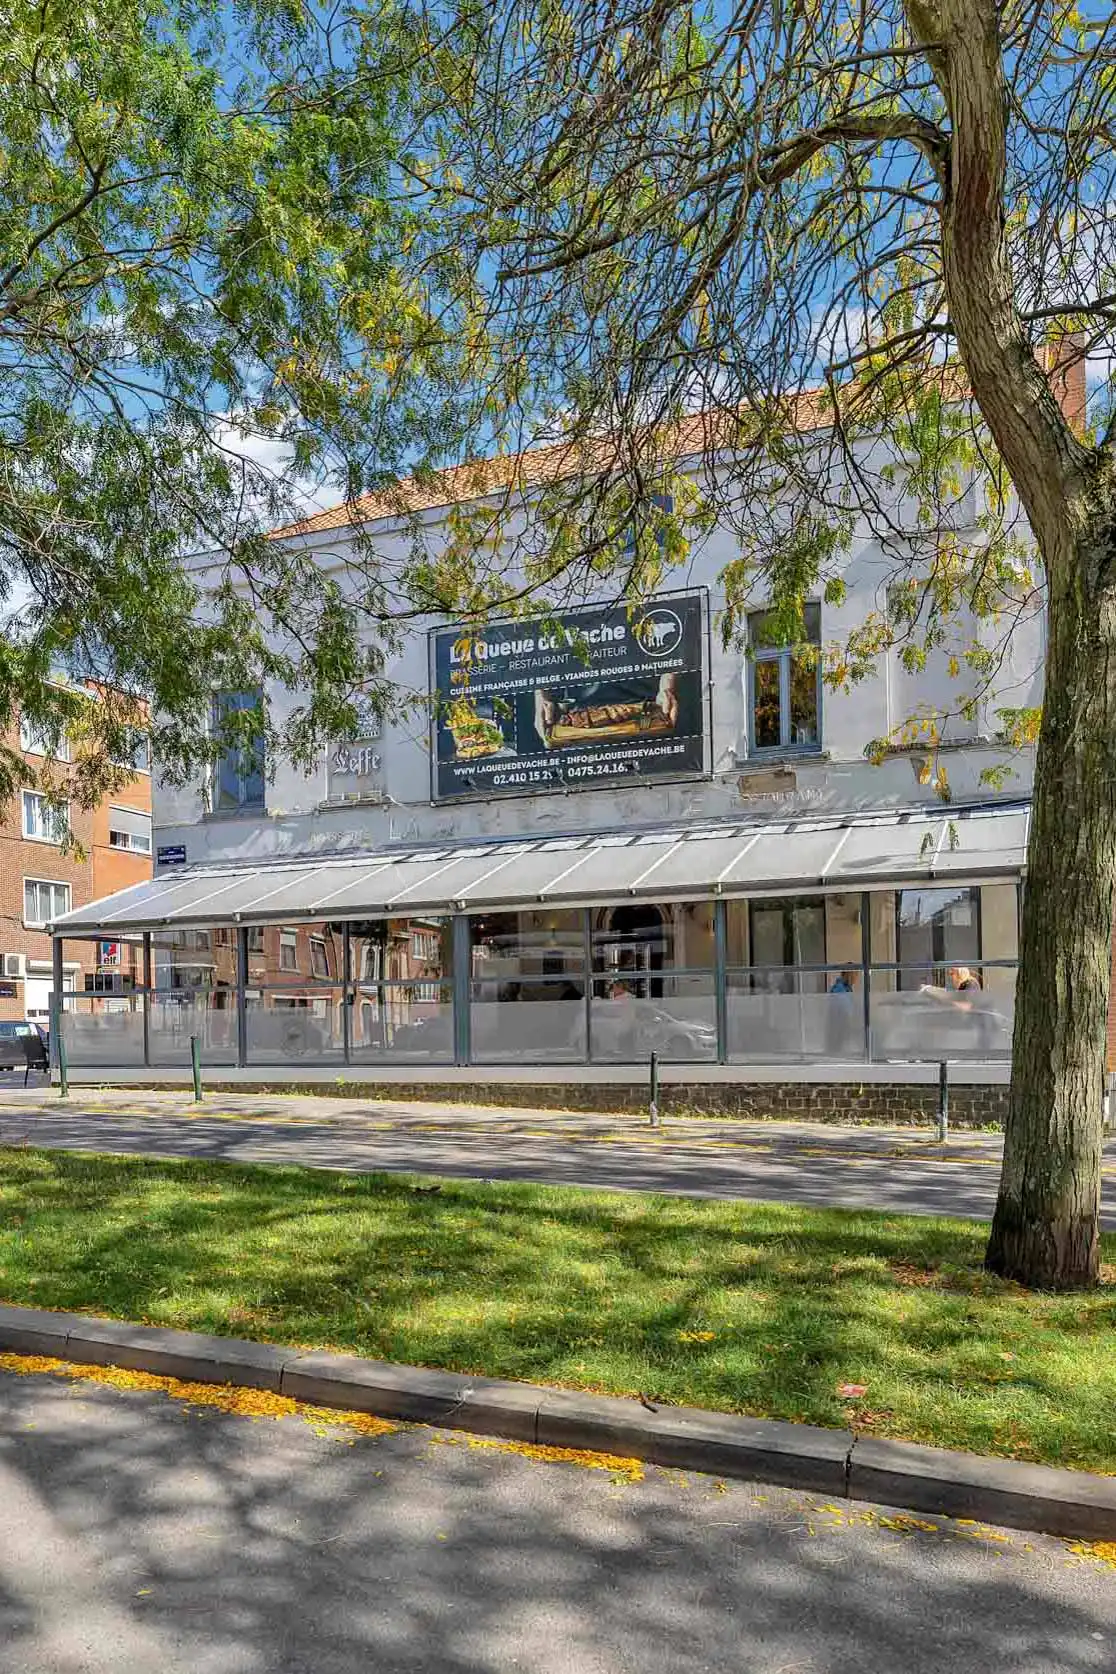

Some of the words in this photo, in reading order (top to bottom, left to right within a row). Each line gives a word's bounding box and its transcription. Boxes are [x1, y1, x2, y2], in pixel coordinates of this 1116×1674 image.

[475, 638, 535, 661] Queue
[449, 664, 497, 679] RASSERIE
[509, 653, 570, 671] RESTAURANT
[584, 646, 628, 661] RAITEUR
[484, 678, 527, 691] FRANÇAISE
[536, 674, 560, 685] BELGE
[564, 669, 599, 682] VIANDES
[600, 664, 633, 676] ROUGES
[641, 657, 684, 671] MATURÉES
[332, 745, 381, 776] Leffe
[566, 744, 685, 764] INFO@LAQUEUEDEVACHE.BE
[568, 760, 640, 777] 0475.24.16.
[104, 956, 116, 964] elf
